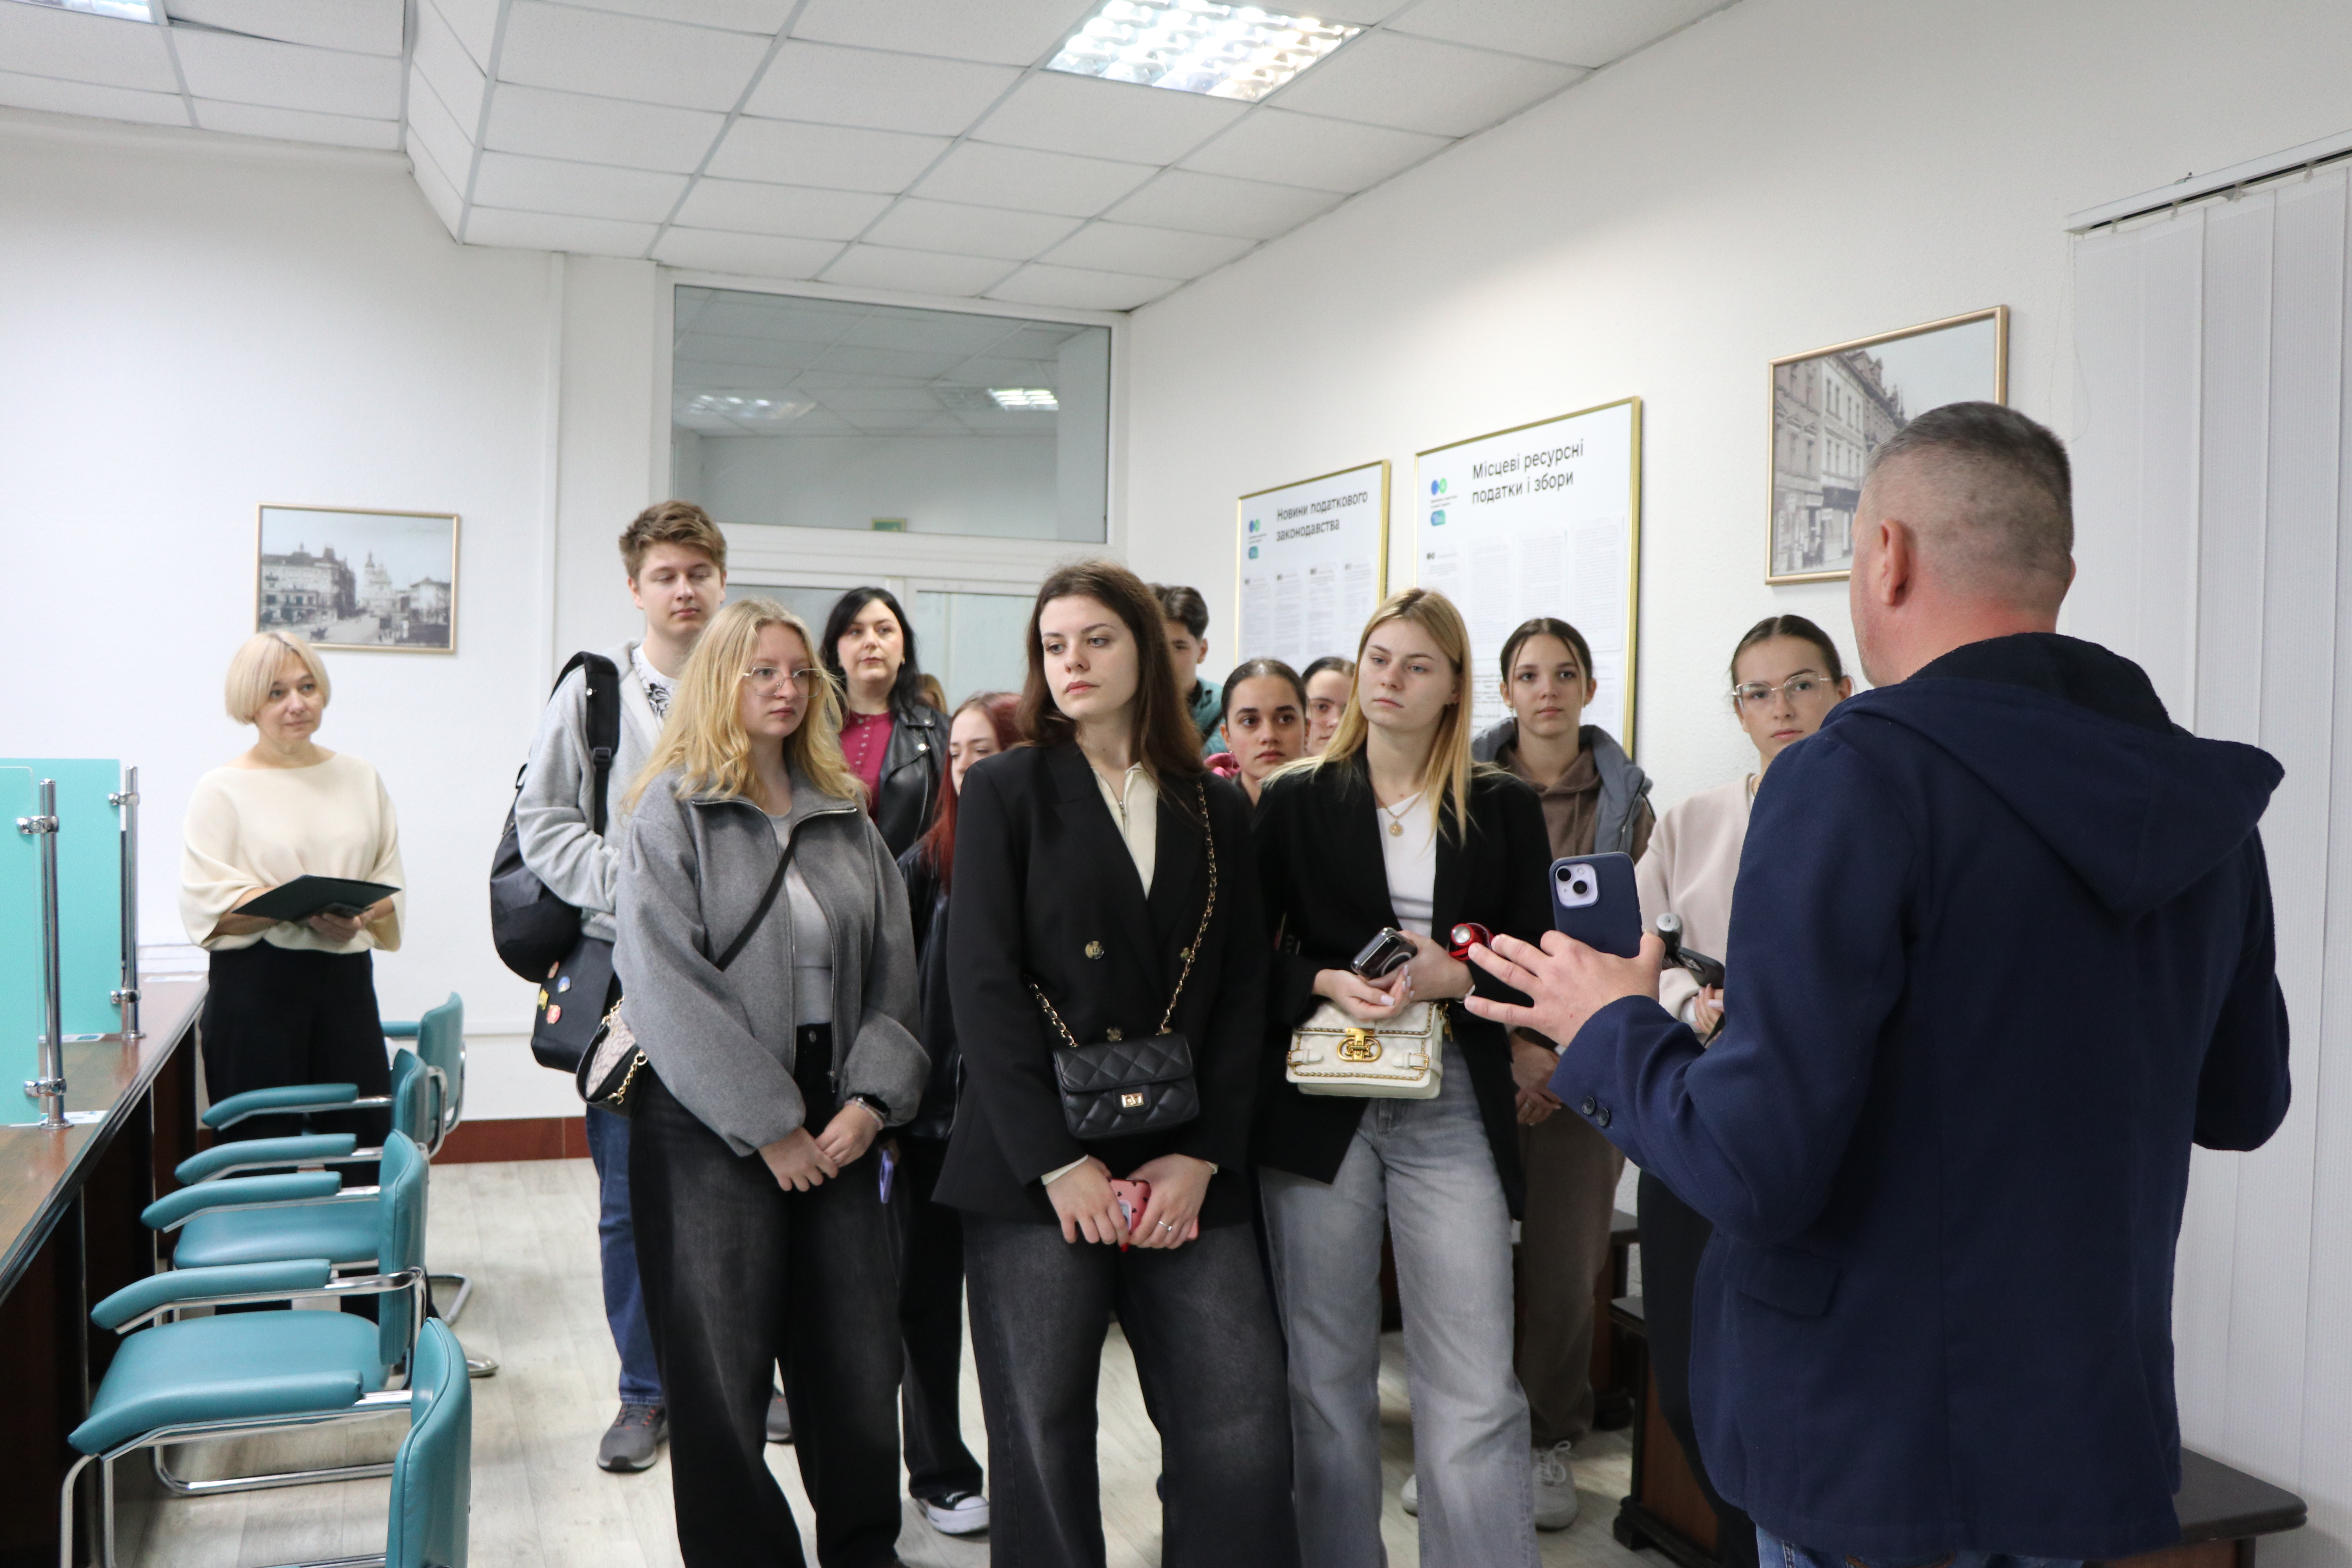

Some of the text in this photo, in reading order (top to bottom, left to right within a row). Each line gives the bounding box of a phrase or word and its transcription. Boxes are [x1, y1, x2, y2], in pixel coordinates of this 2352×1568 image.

[1473, 438, 1583, 479] Місцеві ресурсні
[1472, 482, 1523, 504] податки
[1527, 476, 1530, 494] і
[1534, 472, 1573, 491] збори
[1277, 491, 1368, 521] Новини податкового
[1276, 519, 1340, 541] законодавства
